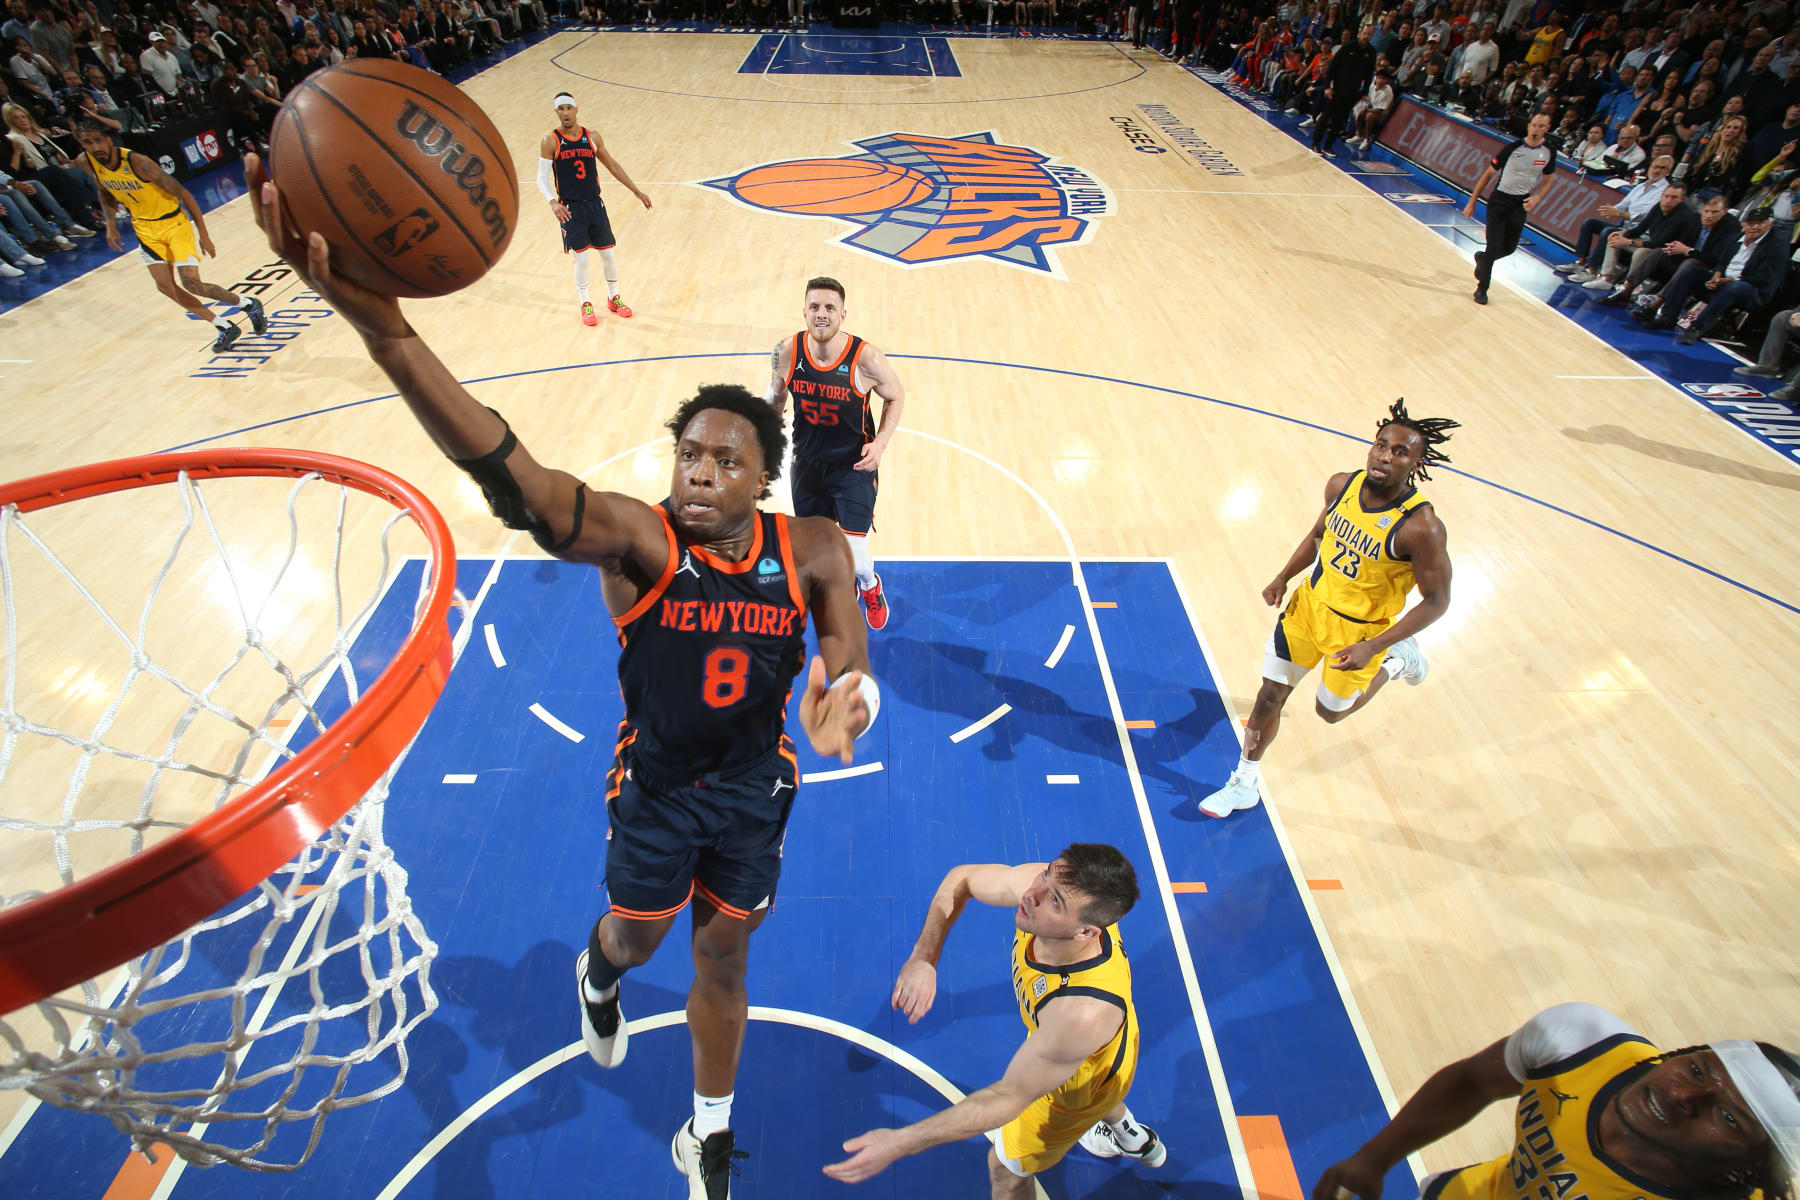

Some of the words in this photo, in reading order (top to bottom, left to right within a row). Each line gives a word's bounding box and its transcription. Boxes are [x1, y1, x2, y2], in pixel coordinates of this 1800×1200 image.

[1109, 116, 1158, 145] CHASE
[1397, 111, 1493, 182] Emirates
[560, 149, 576, 160] NEW
[575, 148, 594, 158] YORK
[574, 159, 586, 179] 3
[395, 98, 507, 249] Wilson
[1041, 164, 1099, 187] NEW
[889, 132, 1085, 263] KNICKS
[1066, 187, 1108, 216] YORK
[792, 379, 817, 396] NEW
[818, 383, 851, 402] YORK
[801, 399, 839, 426] 55
[1327, 509, 1382, 561] INDIANA
[1329, 539, 1361, 580] 23
[660, 599, 725, 633] NEW
[726, 601, 798, 636] YORK
[702, 646, 751, 709] 8
